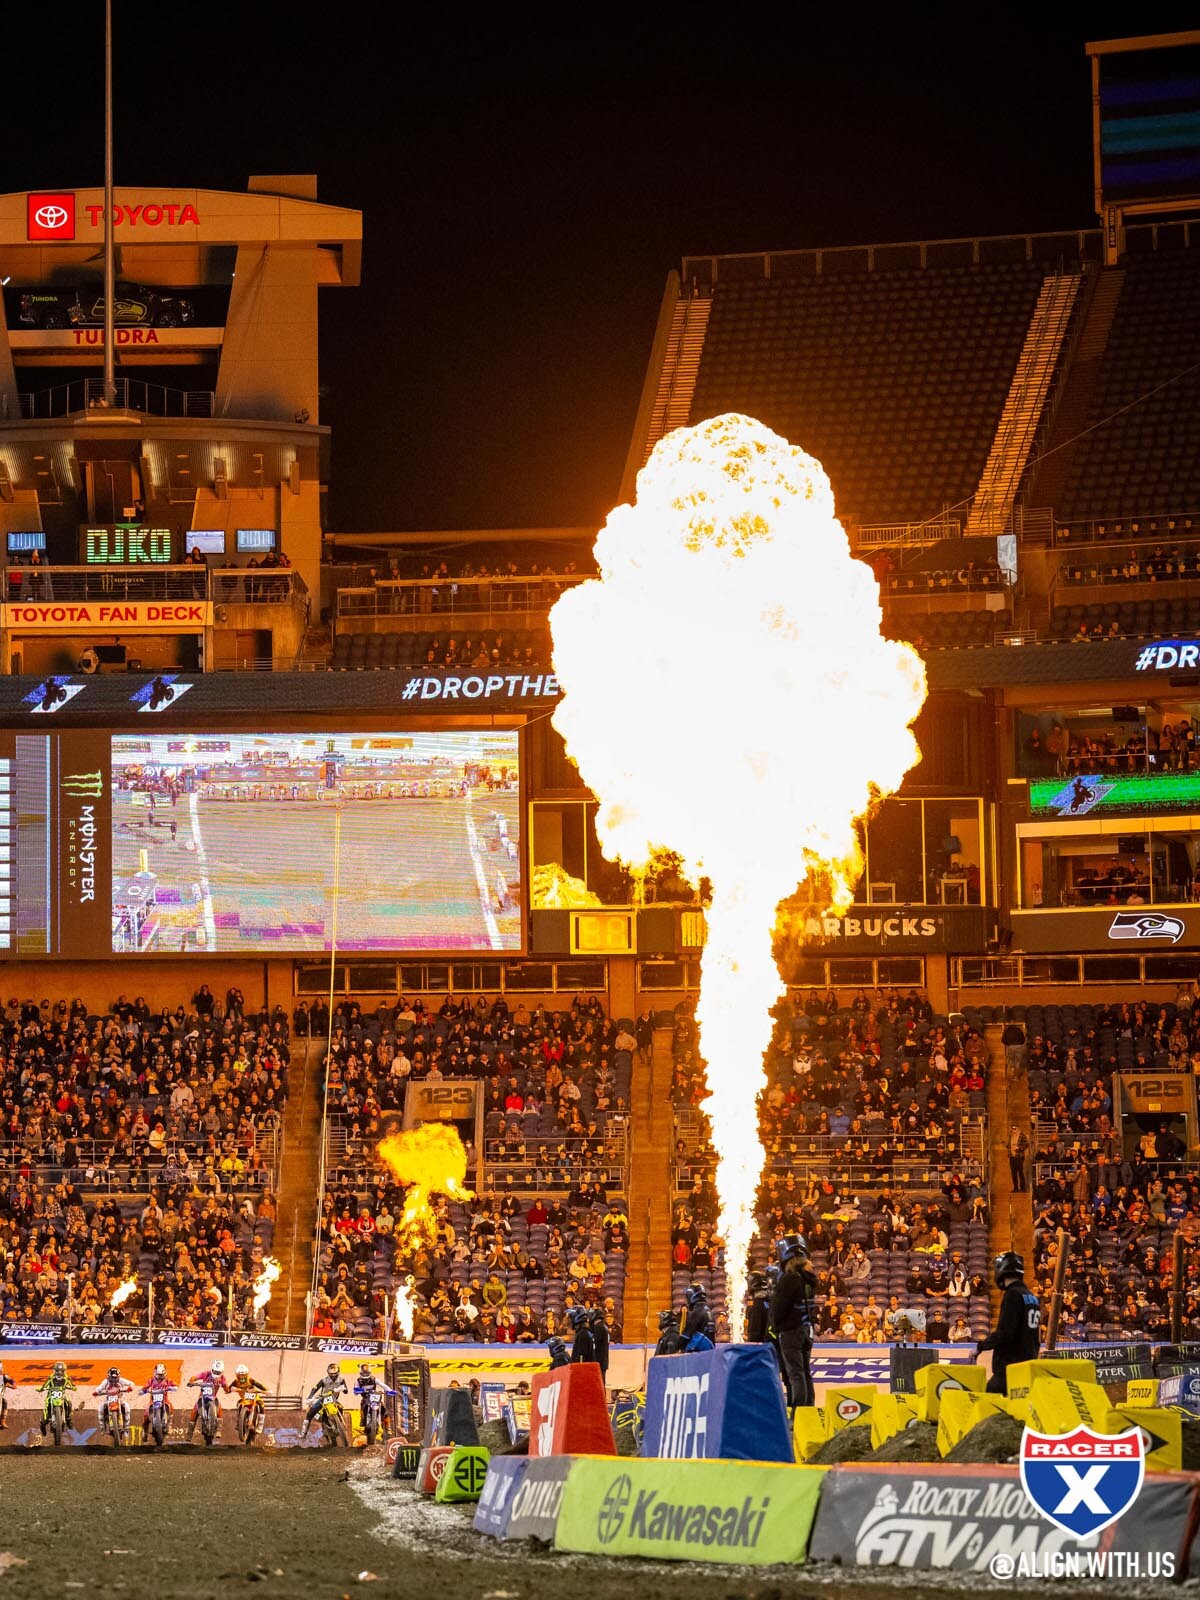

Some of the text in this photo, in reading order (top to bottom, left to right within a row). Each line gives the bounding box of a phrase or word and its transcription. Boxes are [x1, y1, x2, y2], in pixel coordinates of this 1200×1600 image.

[85, 204, 200, 227] TOYOTA
[87, 529, 170, 562] DJ KO
[10, 606, 203, 622] TOYOTA FAN DECK
[79, 805, 97, 903] MONSTER
[419, 1088, 472, 1104] 123
[1128, 1080, 1184, 1097] 125
[1073, 1348, 1123, 1360] MONSTER
[51, 1390, 63, 1399] 30
[900, 1480, 980, 1517] ROCKY
[629, 1489, 769, 1548] Kawasaki
